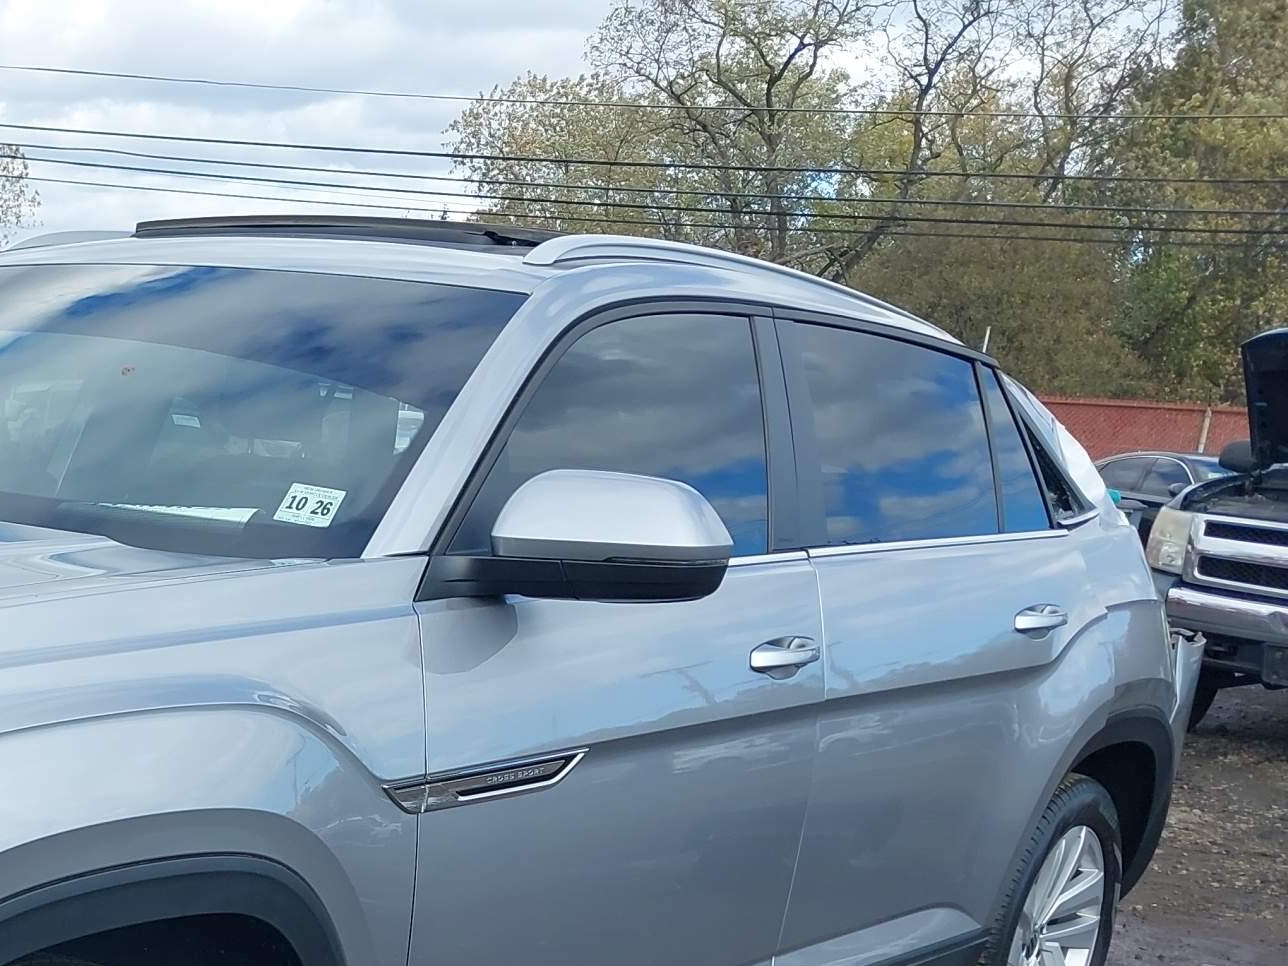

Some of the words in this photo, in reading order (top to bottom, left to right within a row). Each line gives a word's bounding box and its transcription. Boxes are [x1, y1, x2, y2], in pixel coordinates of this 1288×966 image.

[285, 495, 309, 511] 10
[310, 500, 333, 516] 26
[486, 773, 515, 784] CROSS
[517, 767, 544, 778] SPORT
